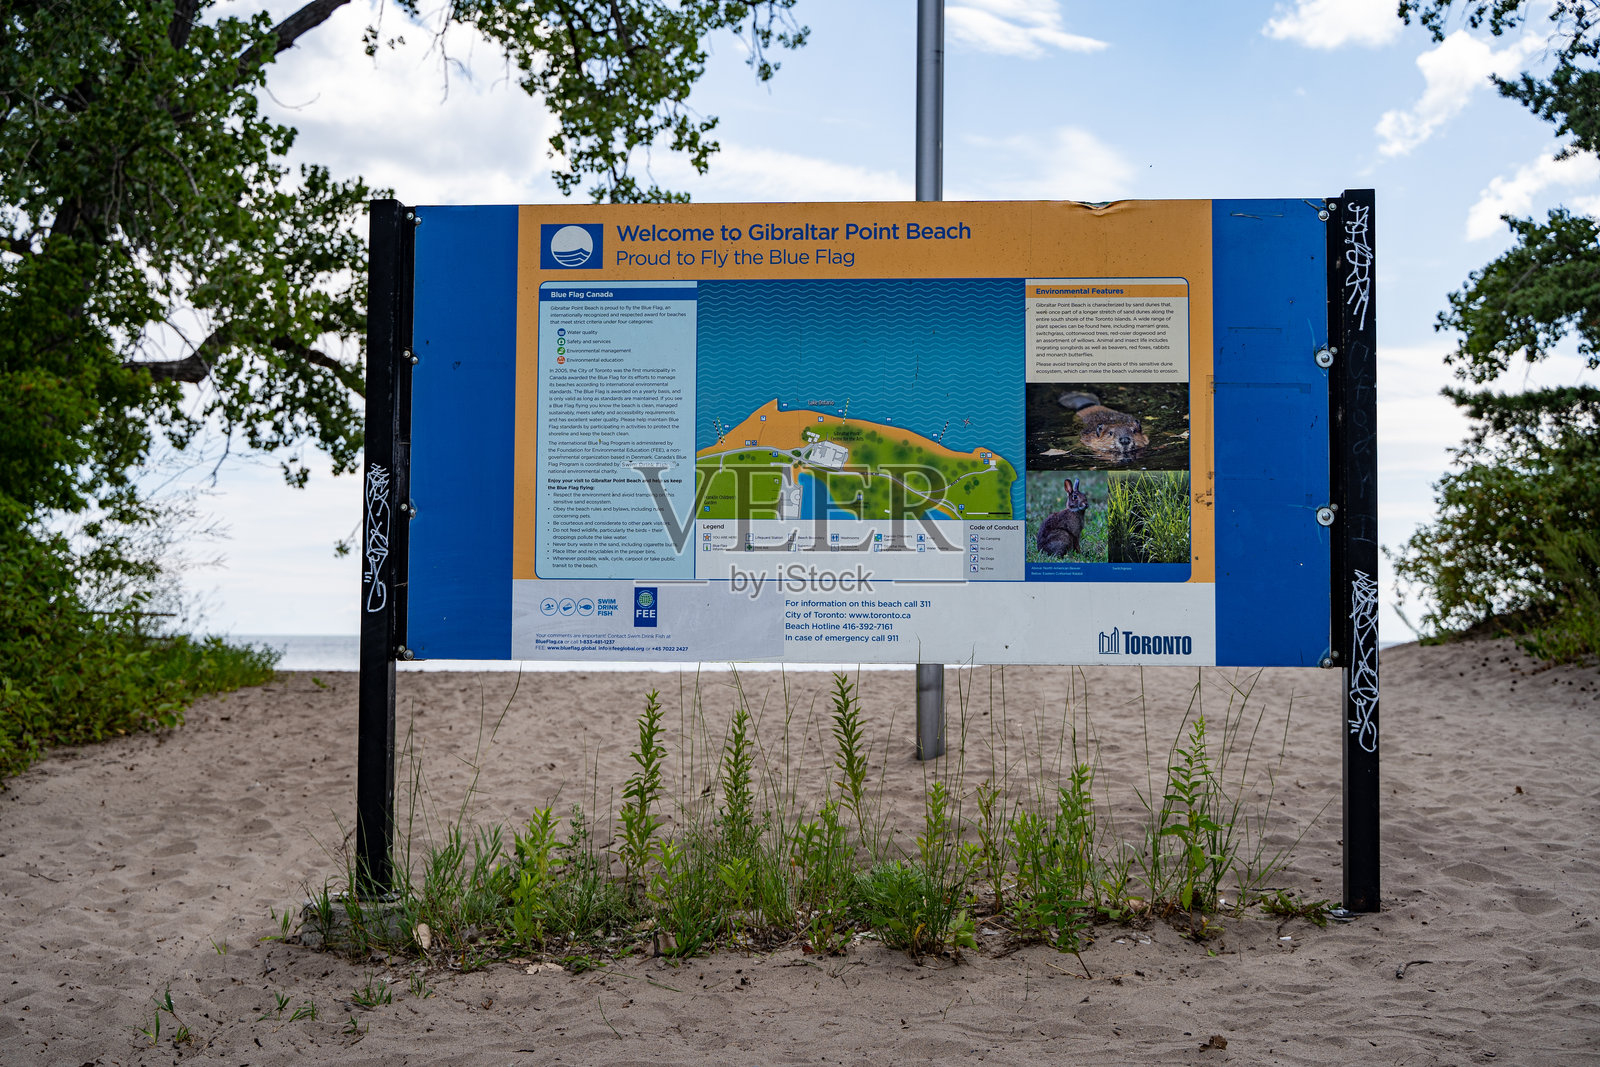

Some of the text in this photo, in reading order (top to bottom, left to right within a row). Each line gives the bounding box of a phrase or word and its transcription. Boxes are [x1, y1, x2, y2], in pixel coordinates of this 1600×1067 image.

[617, 223, 971, 241] Welcome to Gibraltar Point Beach
[617, 249, 854, 269] Proud to Fly the Blue Flag
[786, 611, 801, 620] City
[1122, 631, 1192, 655] TORONTO
